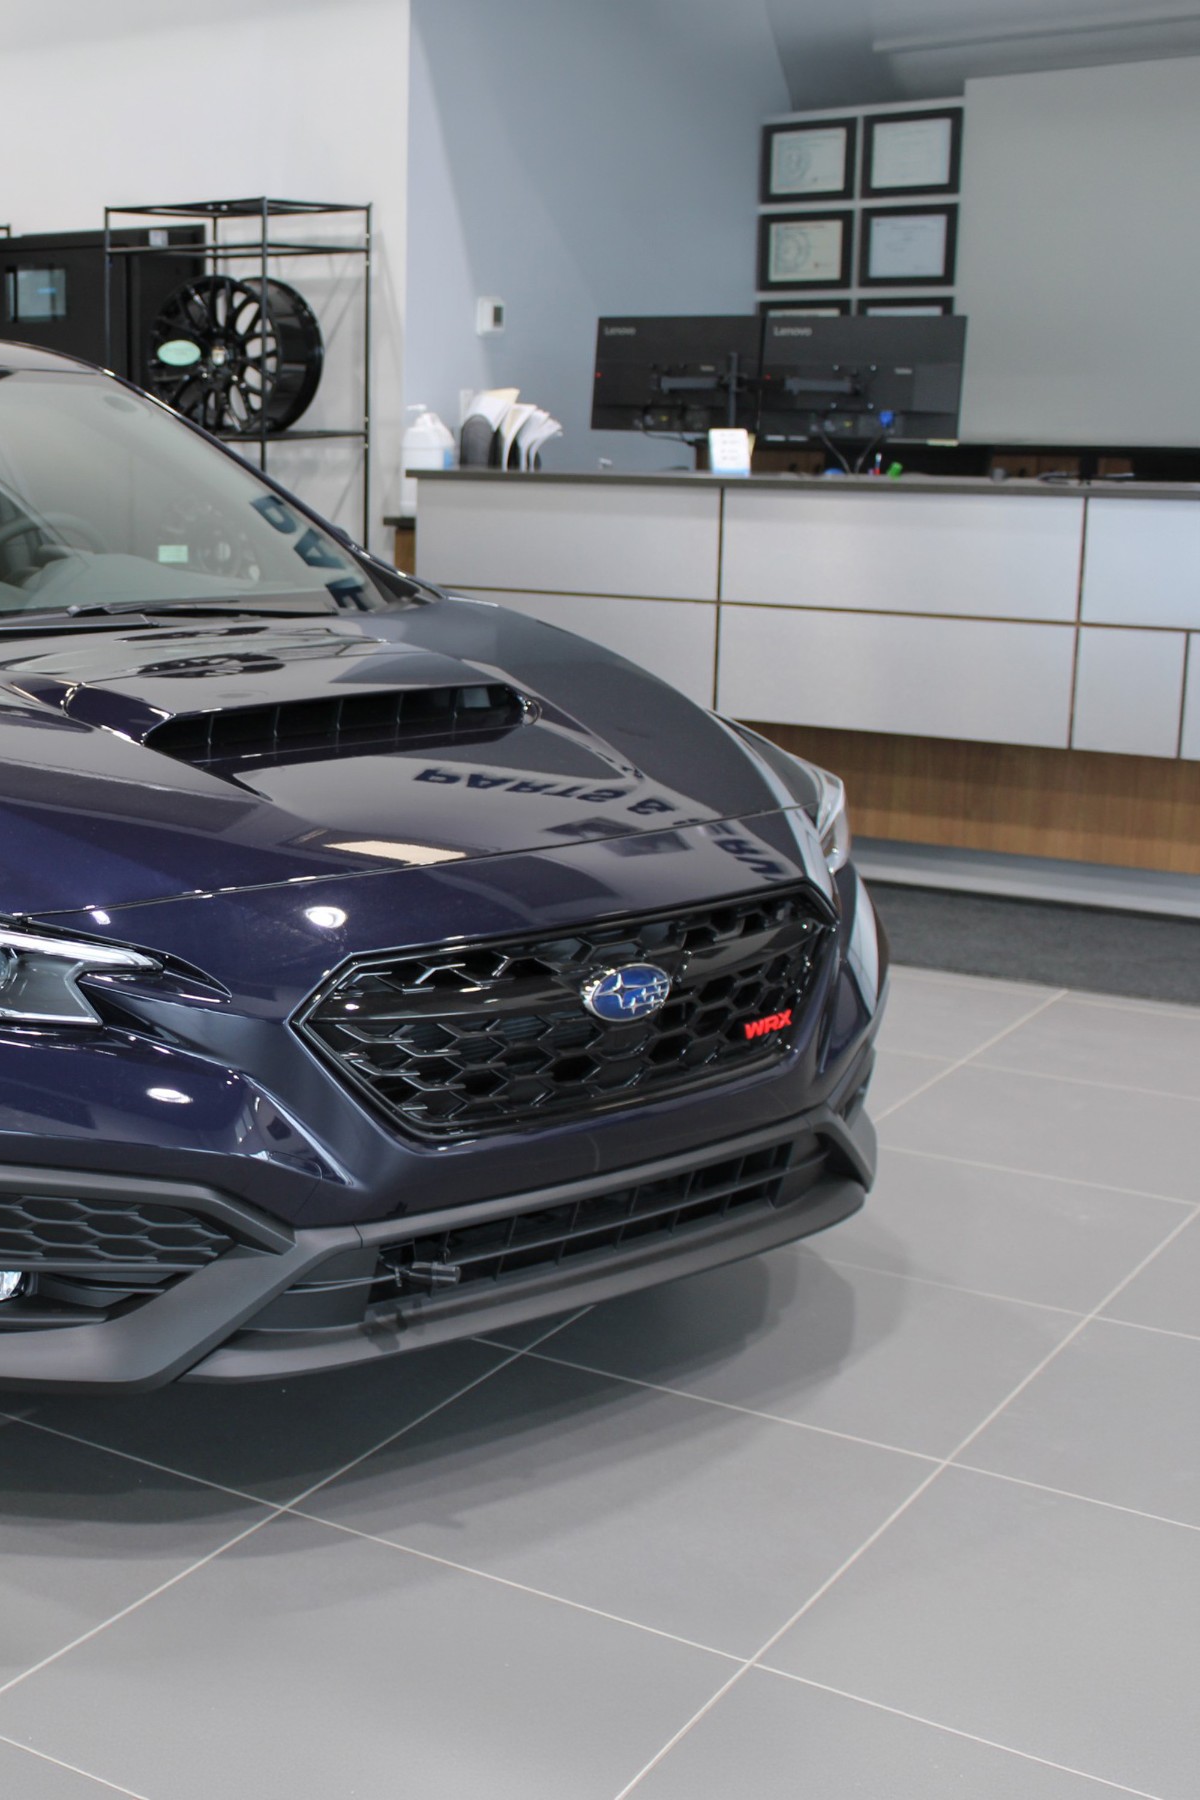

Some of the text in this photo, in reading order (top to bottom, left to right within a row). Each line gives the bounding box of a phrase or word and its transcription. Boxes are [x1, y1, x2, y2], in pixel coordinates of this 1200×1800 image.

[604, 326, 636, 336] Lenovo
[773, 326, 813, 337] Lenovo
[745, 1009, 792, 1039] WRX
